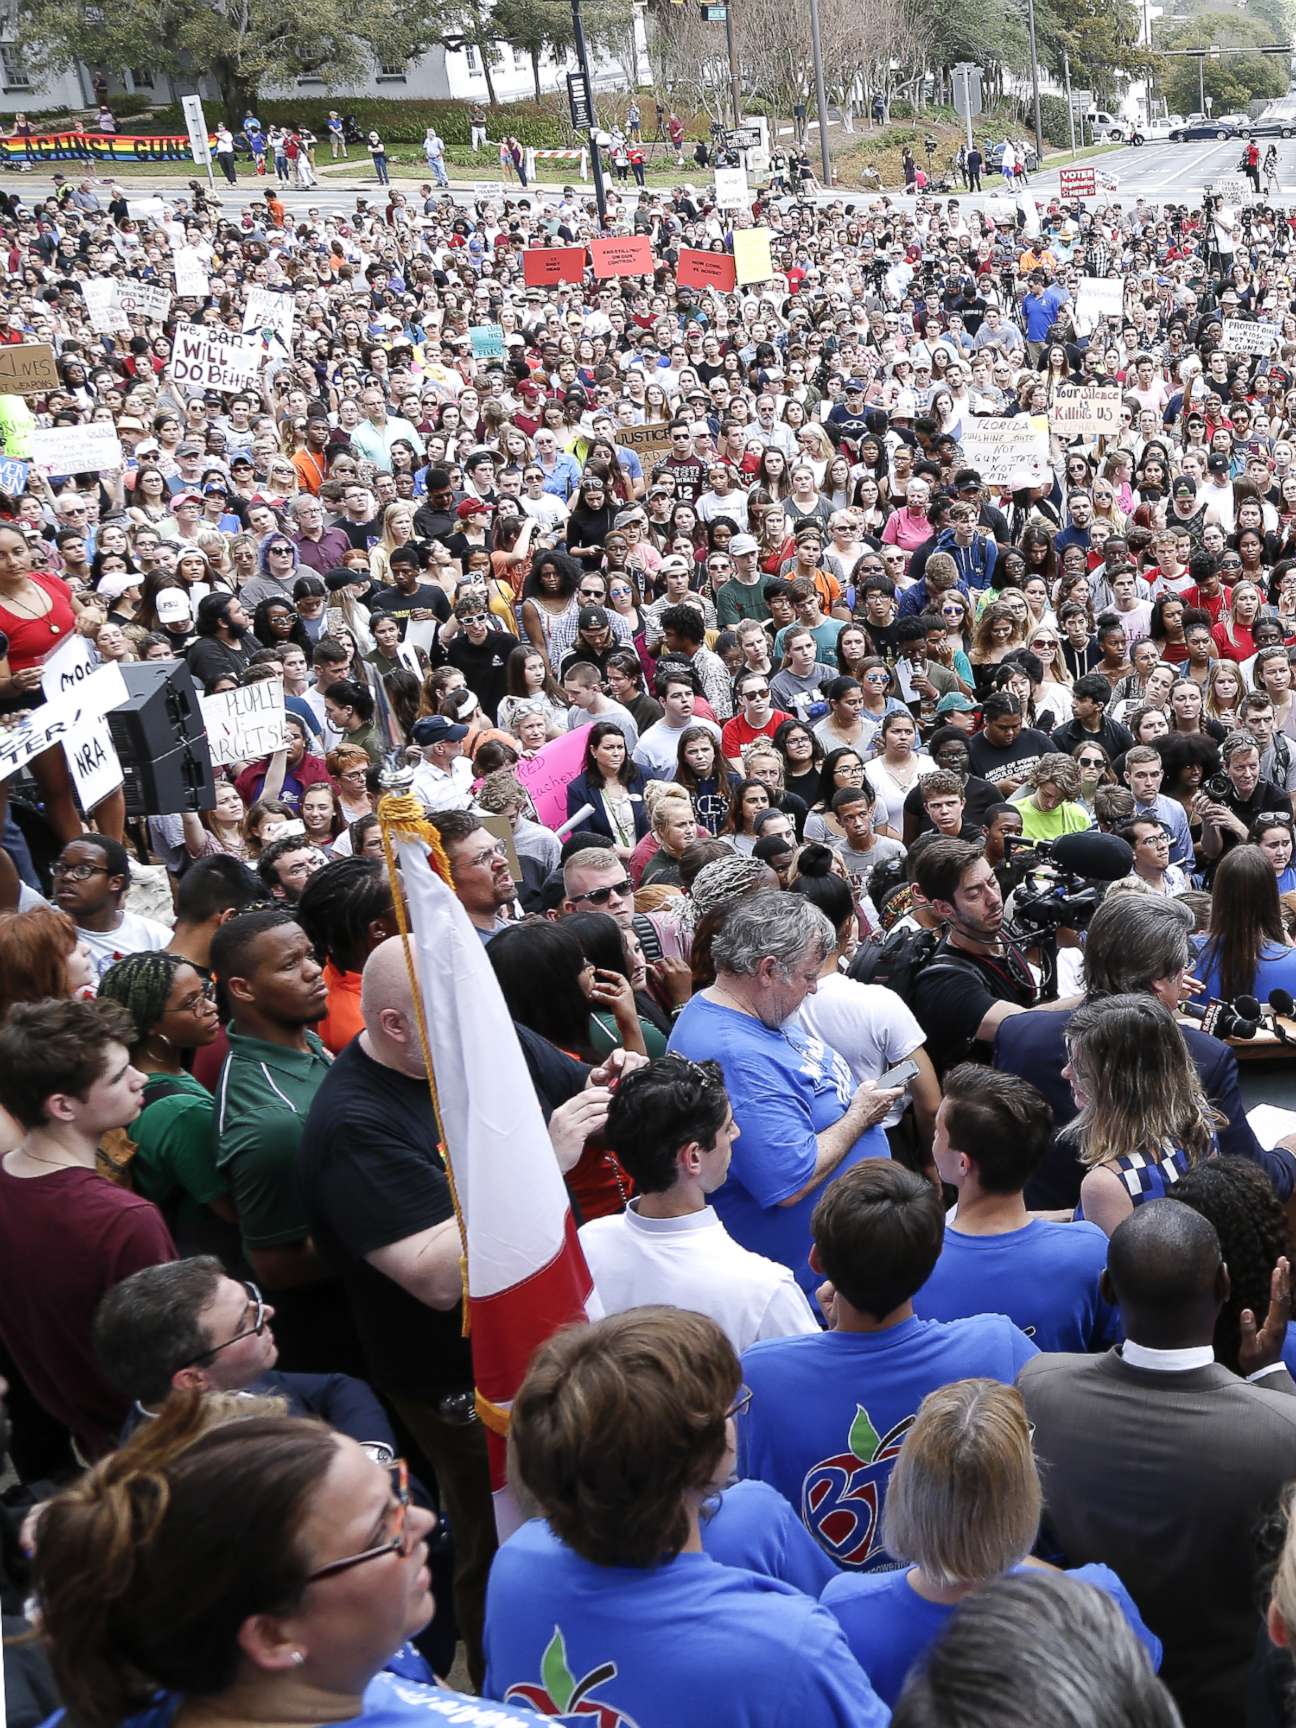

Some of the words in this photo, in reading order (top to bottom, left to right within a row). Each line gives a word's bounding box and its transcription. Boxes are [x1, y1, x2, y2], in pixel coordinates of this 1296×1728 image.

[24, 136, 116, 160] AGAINST
[1061, 170, 1094, 180] VOTER
[253, 312, 284, 329] FEAR
[1228, 321, 1261, 332] PROTECT
[1096, 406, 1113, 421] US
[976, 418, 1029, 432] FLORIDA
[962, 435, 1003, 443] SUNSHINE
[994, 444, 1015, 454] NOT
[974, 453, 1000, 463] GUN
[990, 463, 1017, 472] NOT
[677, 486, 693, 500] 12
[225, 680, 281, 717] PEOPLE
[208, 719, 286, 764] ARGETS!
[73, 736, 107, 779] NRA
